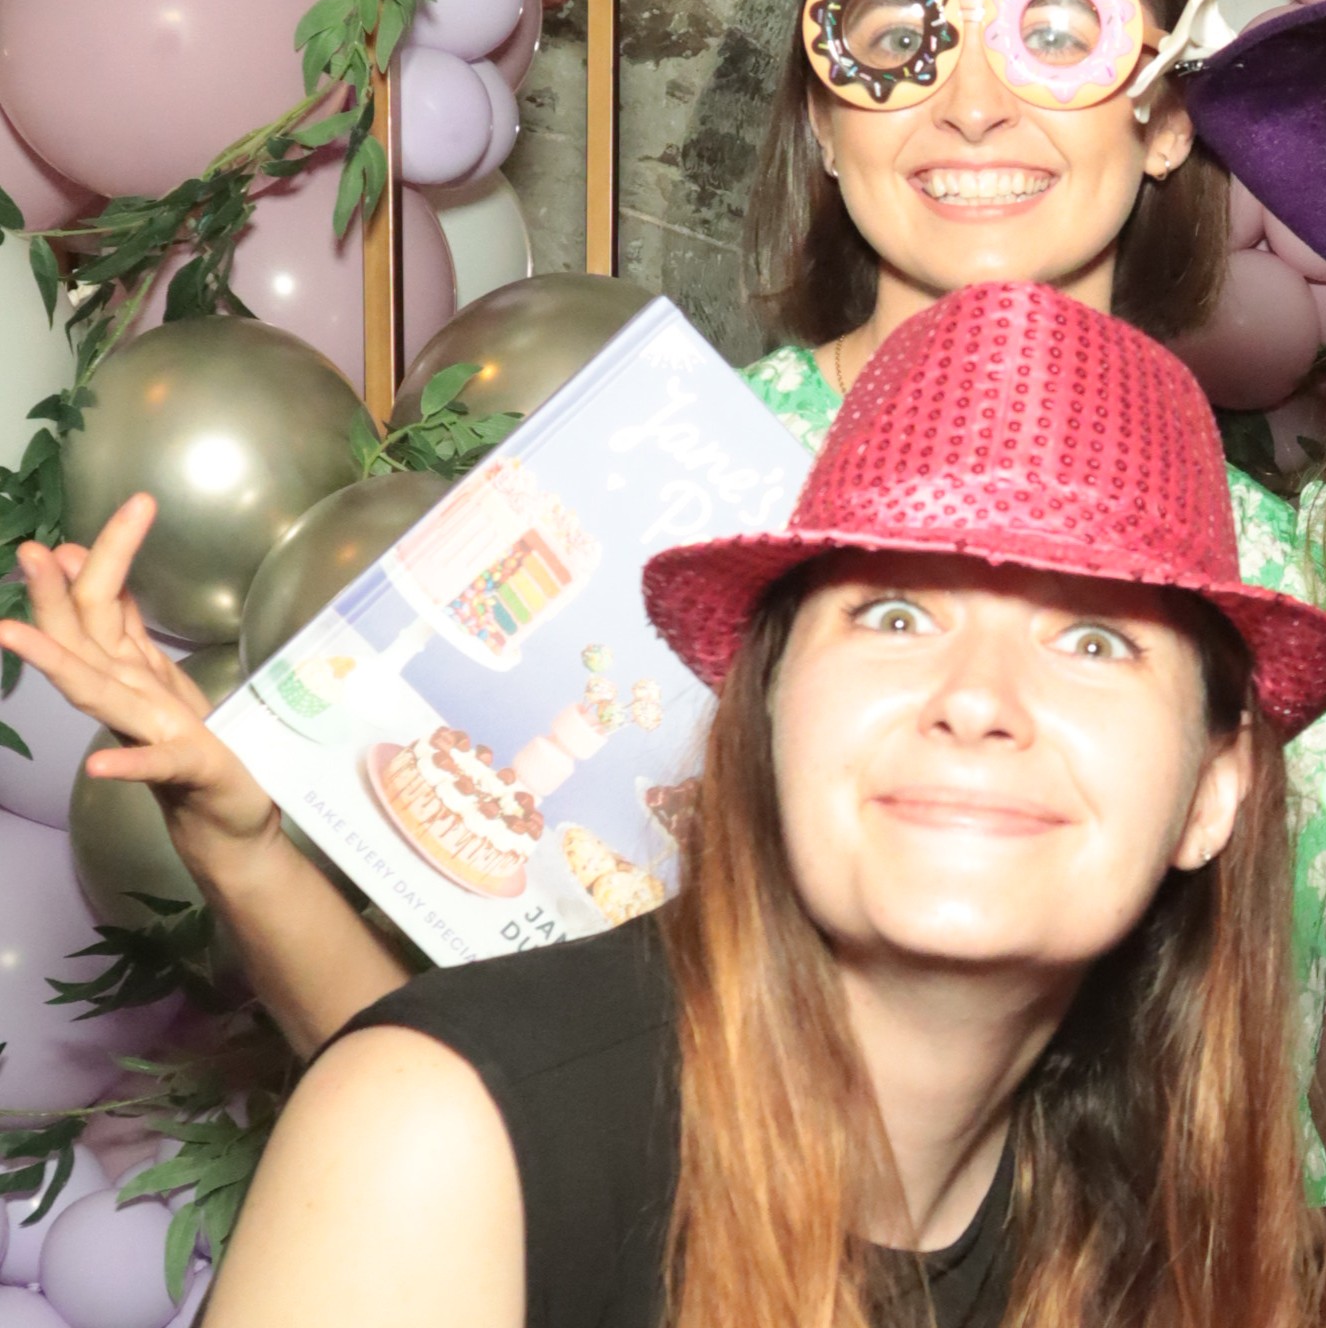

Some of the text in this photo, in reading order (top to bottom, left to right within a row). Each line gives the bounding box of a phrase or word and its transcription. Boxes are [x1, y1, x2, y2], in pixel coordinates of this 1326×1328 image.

[608, 376, 785, 527] Jane's
[303, 790, 478, 962] BAKE EVERY DAY SPECIA
